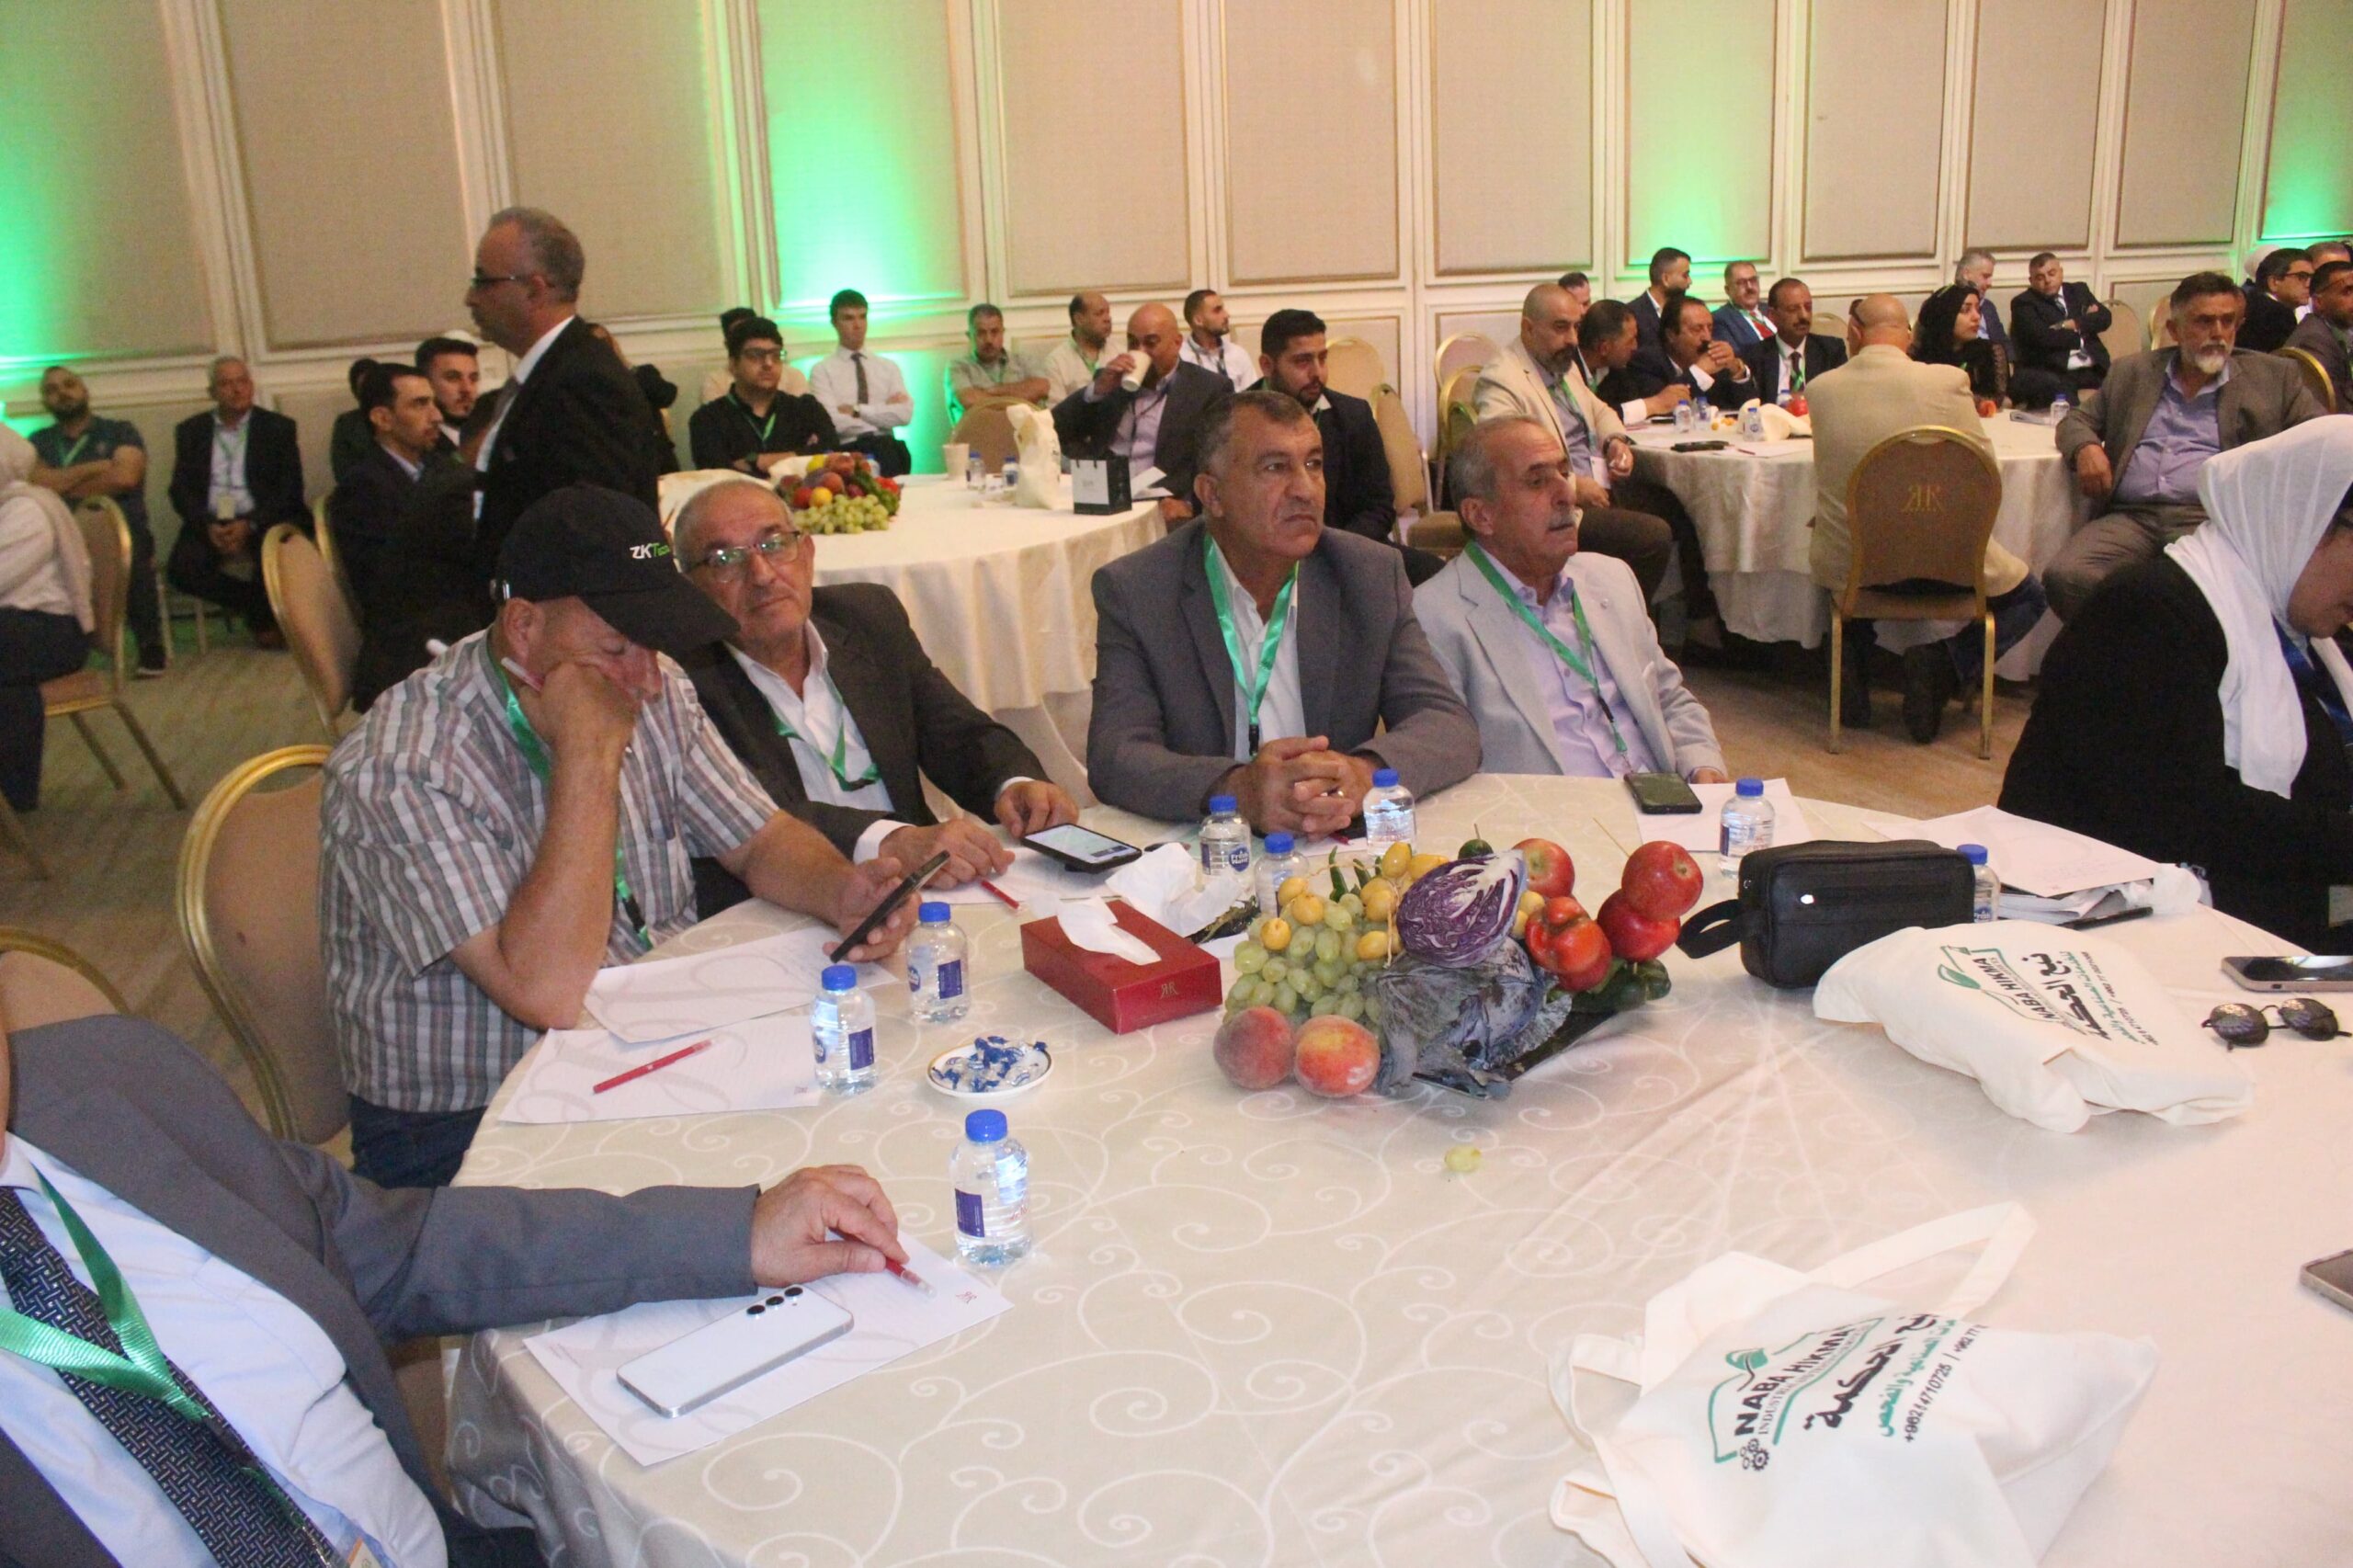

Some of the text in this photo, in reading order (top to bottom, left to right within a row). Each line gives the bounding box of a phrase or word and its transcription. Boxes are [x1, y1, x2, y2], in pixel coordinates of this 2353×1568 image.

[1972, 958, 2061, 1019] NABA HIKMA
[2021, 952, 2072, 976] نبع
[1734, 1376, 1795, 1436] NABA
[1782, 1328, 1856, 1372] HIKMA
[1802, 1337, 1907, 1430] الحكمة
